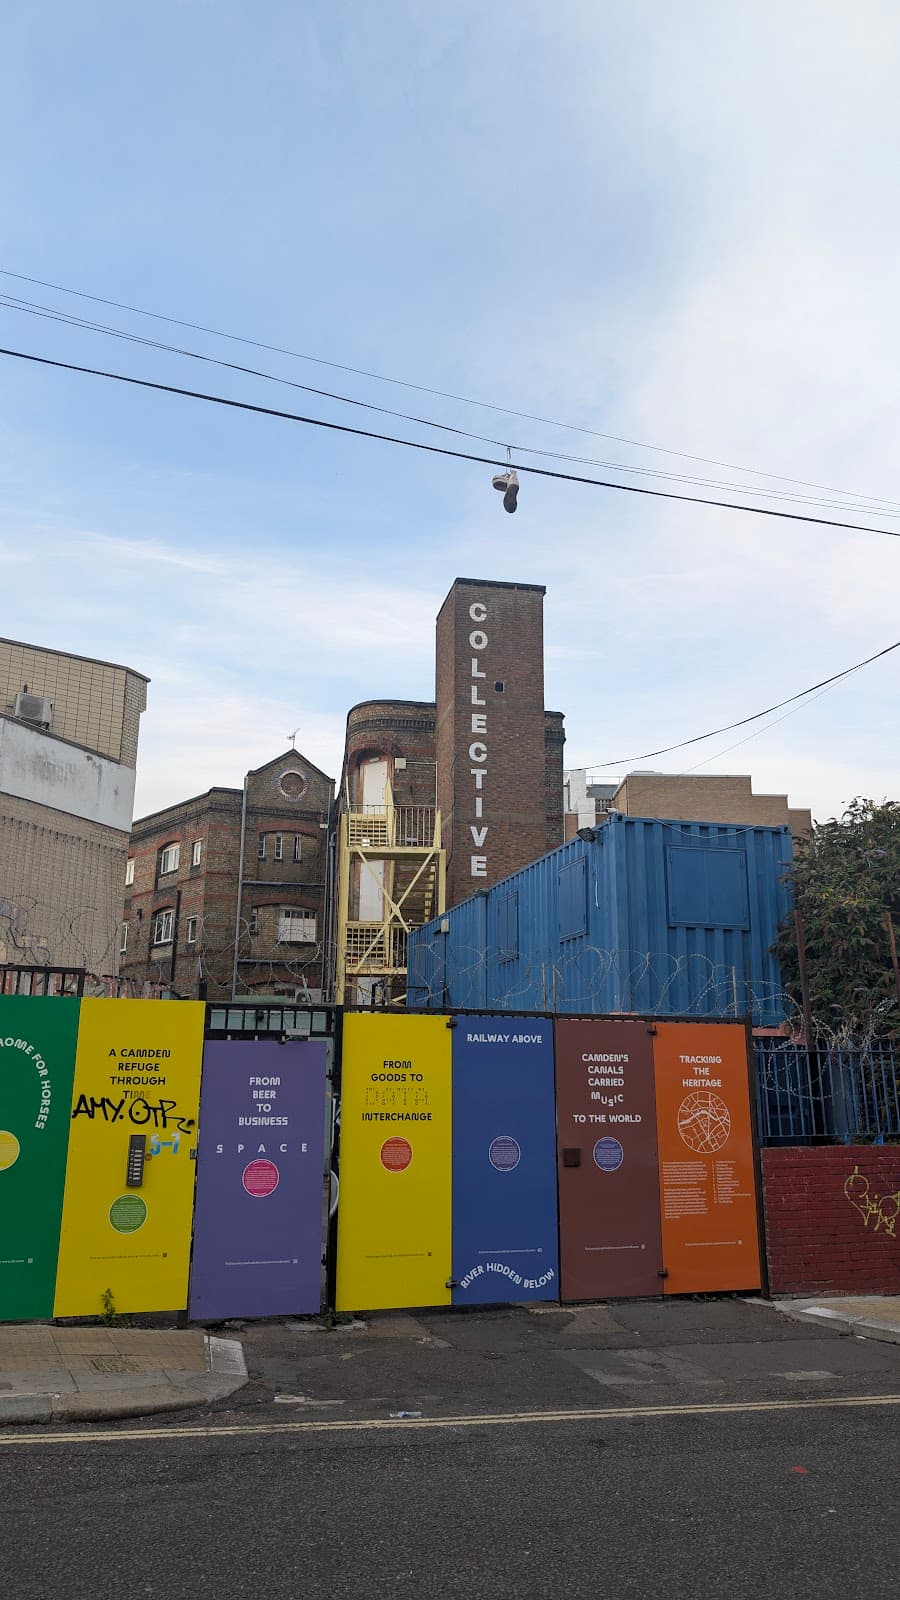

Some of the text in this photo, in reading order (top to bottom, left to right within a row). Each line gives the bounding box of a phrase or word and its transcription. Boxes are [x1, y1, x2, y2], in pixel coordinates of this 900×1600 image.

[468, 603, 489, 877] COLLECTIVE
[467, 1034, 543, 1044] RAILWAY ABOVE
[108, 1048, 171, 1058] A CAMDEN
[582, 1054, 629, 1063] CAMDEN'S
[680, 1055, 723, 1064] TRACKING
[31, 1053, 49, 1078] FOR
[118, 1062, 160, 1072] REFUGE
[383, 1060, 412, 1069] FROM
[587, 1066, 624, 1075] CANALS
[693, 1067, 710, 1076] THE
[110, 1076, 166, 1086] THROUGH
[250, 1076, 281, 1086] FROM
[371, 1073, 424, 1082] GOODS TO
[588, 1078, 625, 1087] CARRIED
[683, 1078, 723, 1087] HERITAGE
[122, 1090, 151, 1099] TIME
[253, 1090, 277, 1099] BEER
[591, 1091, 624, 1107] MUSIC
[35, 1079, 52, 1130] HORSES
[256, 1103, 272, 1113] TO
[361, 1111, 433, 1121] INTERCHANGE
[573, 1114, 642, 1123] TO THE WORLD
[238, 1117, 289, 1126] BUSINESS
[460, 1262, 556, 1288] RIVER HIDDEN BELOW
